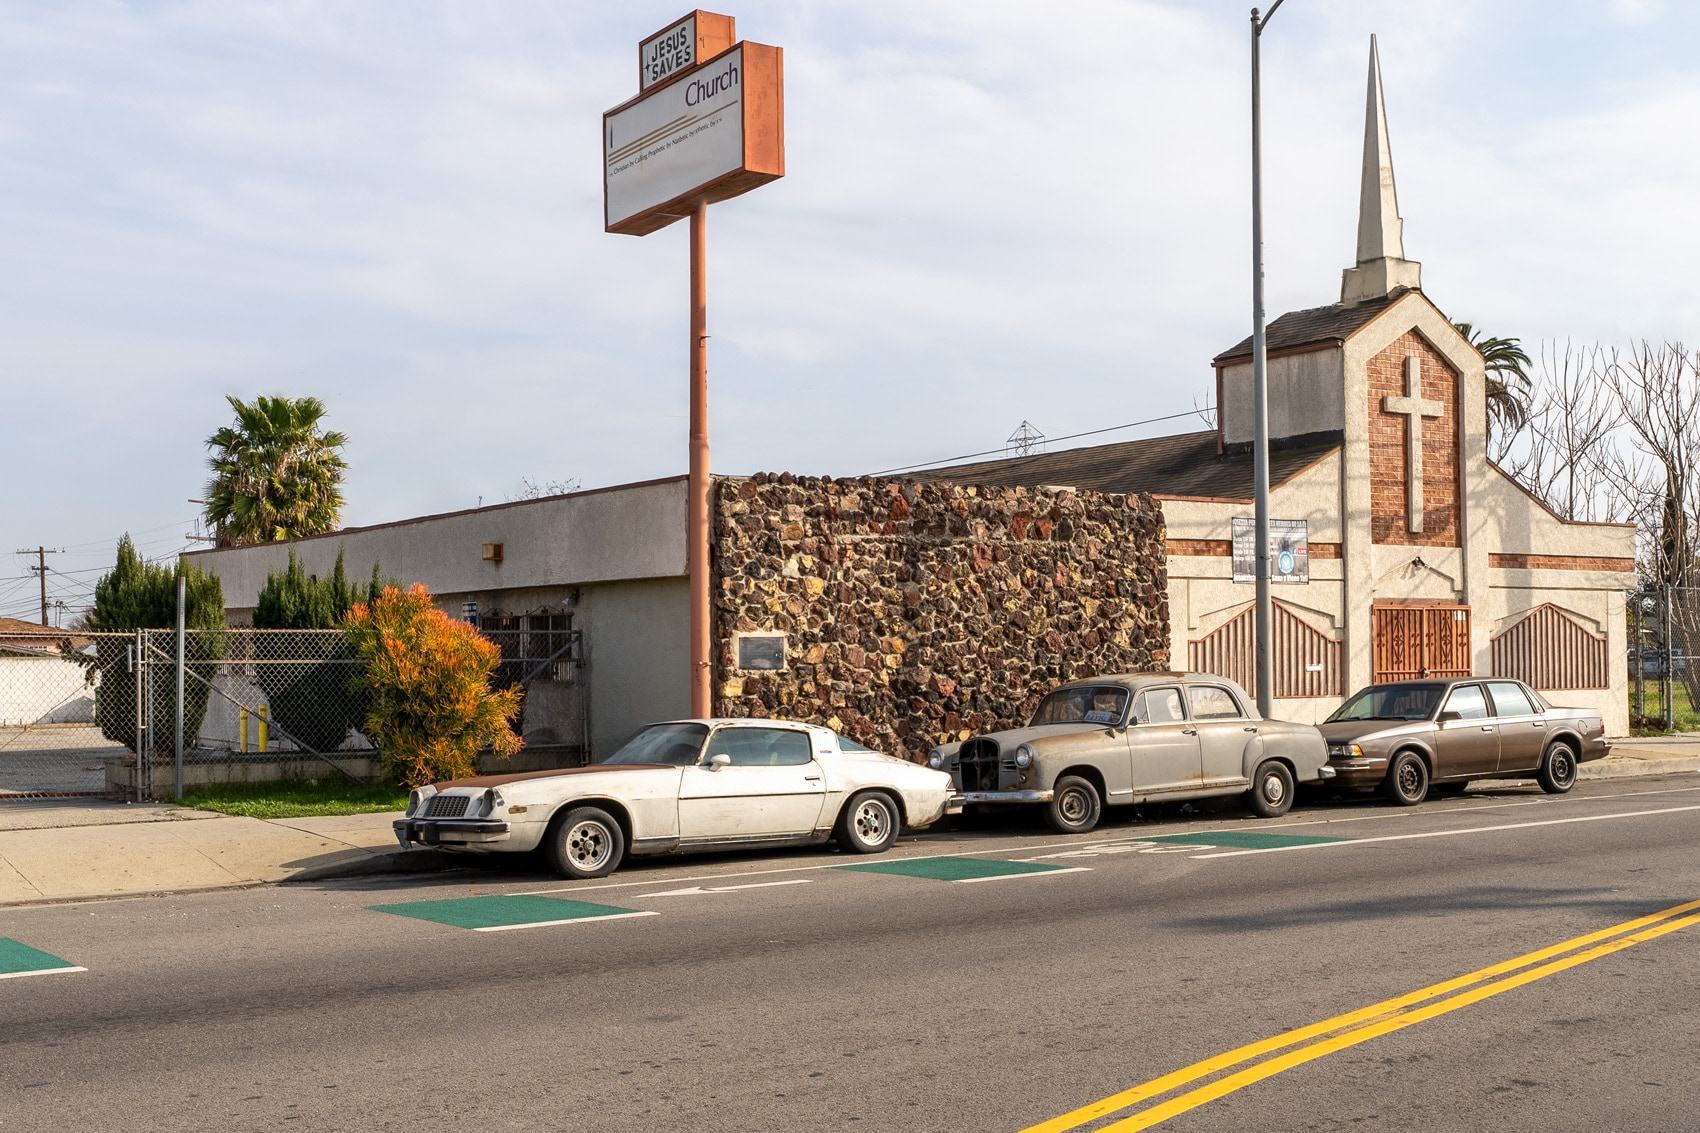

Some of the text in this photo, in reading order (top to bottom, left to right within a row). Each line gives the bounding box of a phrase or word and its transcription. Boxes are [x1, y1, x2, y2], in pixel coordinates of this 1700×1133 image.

[651, 26, 687, 63] JESUS
[651, 44, 692, 82] SAVES
[685, 62, 738, 107] Church
